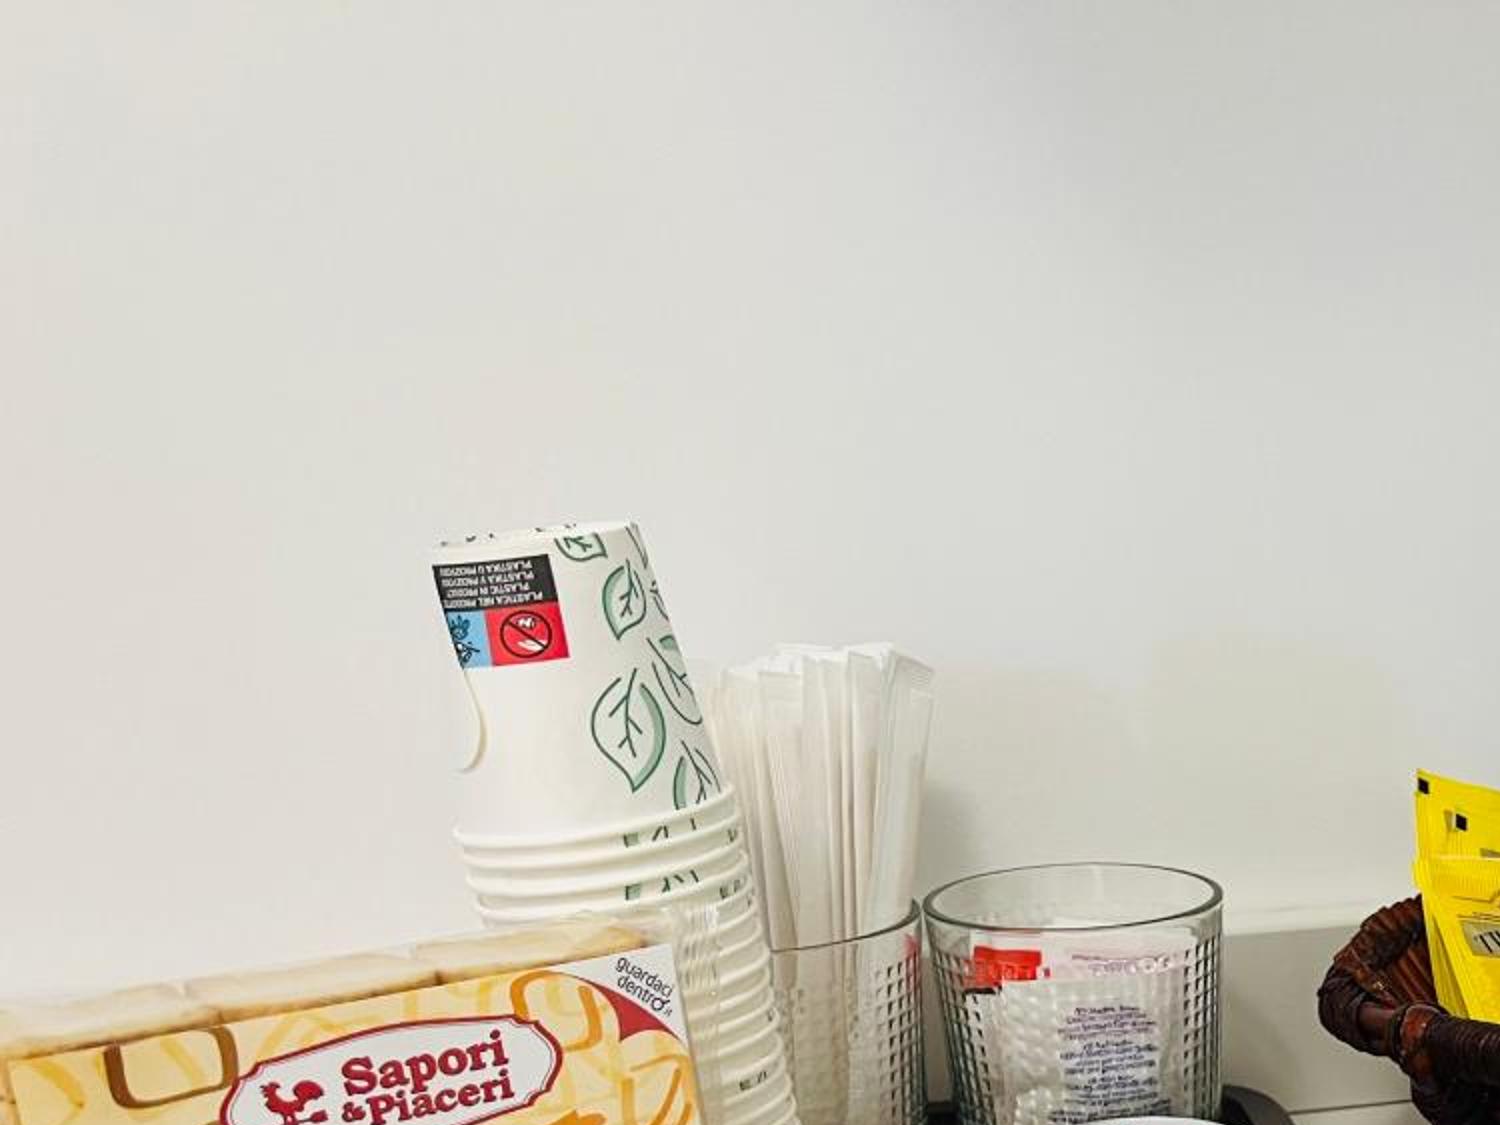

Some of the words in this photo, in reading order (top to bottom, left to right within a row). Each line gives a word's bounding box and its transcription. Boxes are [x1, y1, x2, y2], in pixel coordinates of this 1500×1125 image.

[490, 582, 530, 596] PLASTIC
[496, 591, 543, 605] PLASTICA
[341, 1029, 509, 1096] Sapori
